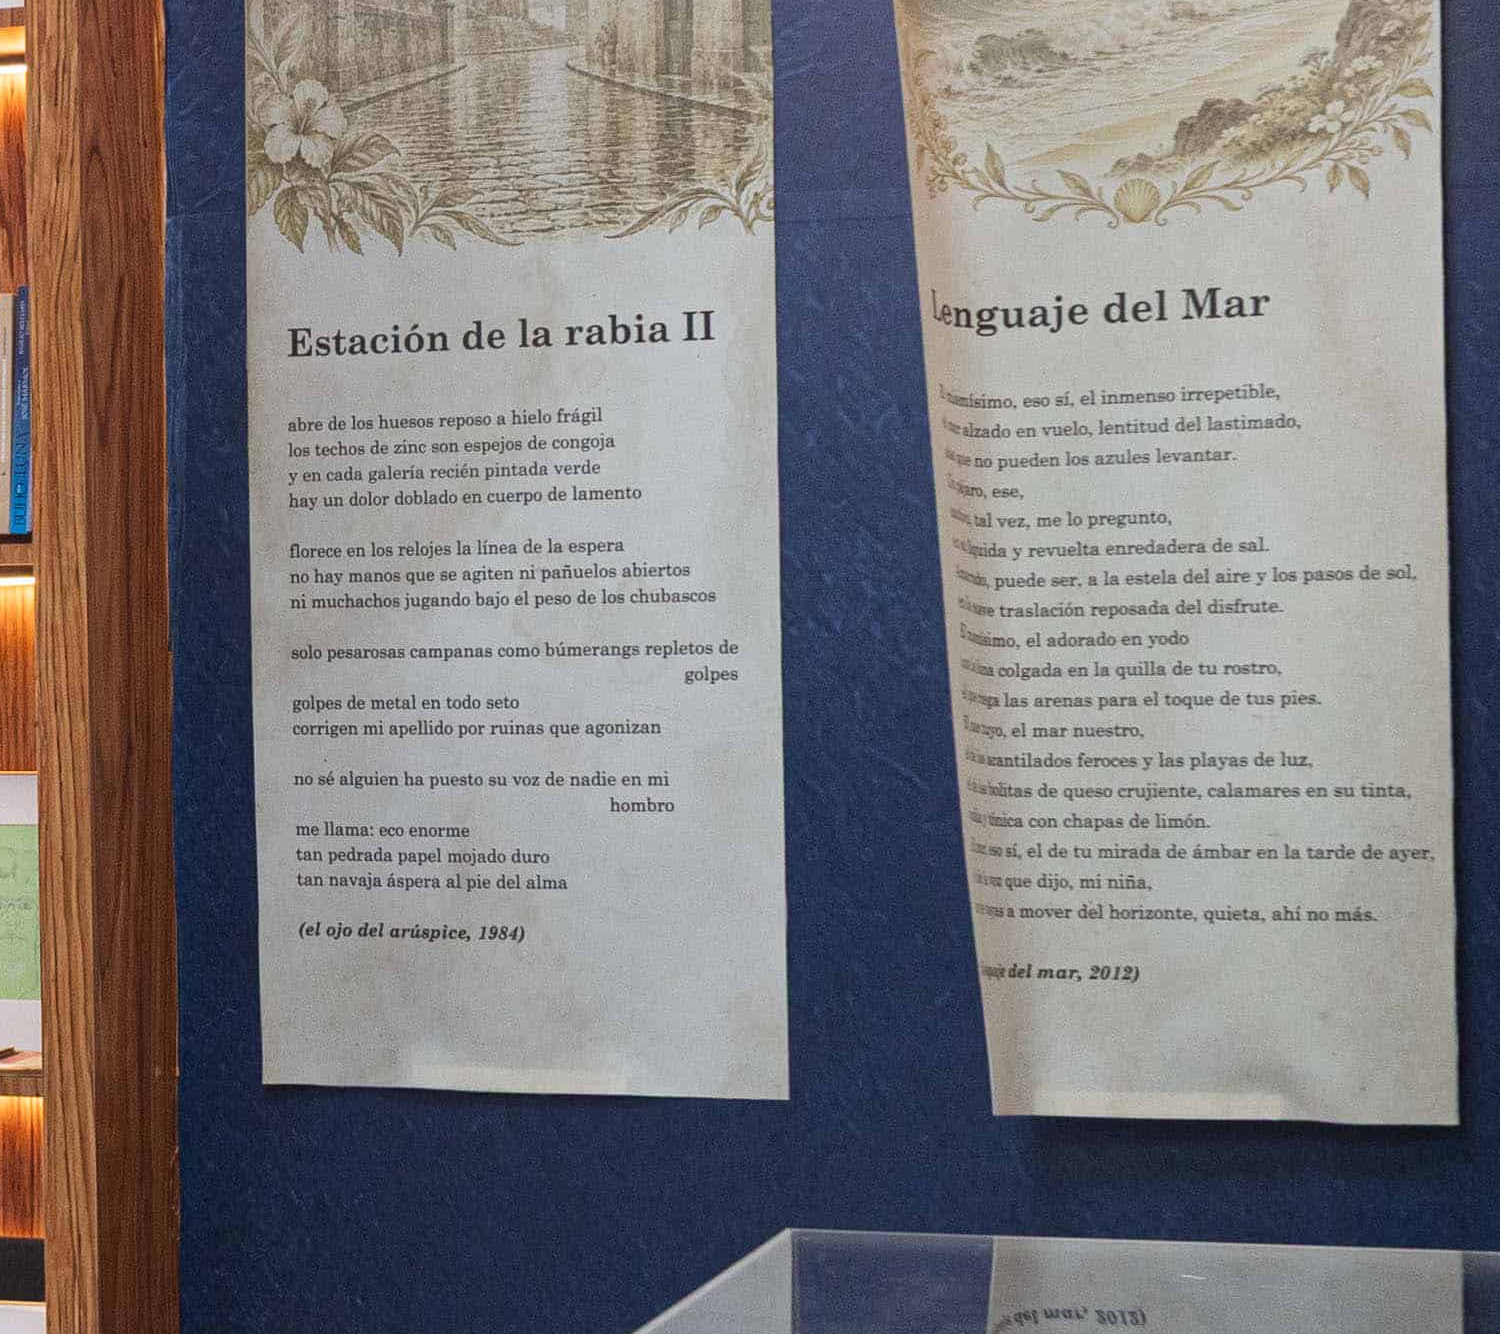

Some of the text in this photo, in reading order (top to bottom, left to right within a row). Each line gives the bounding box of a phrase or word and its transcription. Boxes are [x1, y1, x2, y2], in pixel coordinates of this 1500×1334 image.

[930, 286, 1271, 338] Lenguaje del Mar
[287, 309, 715, 359] Estación de la rabia II
[287, 406, 603, 434] abre de los huesos reposo a hielo frágil
[971, 509, 1173, 531] tal vez, me lo pregunto,
[1002, 689, 1323, 711] las arenas para el toque de tus pies.
[296, 871, 568, 894] tan navaja áspera al pie del alma
[298, 920, 526, 945] (el ojo del arúspice, 1984)
[1007, 961, 1141, 985] del mar, 2012)
